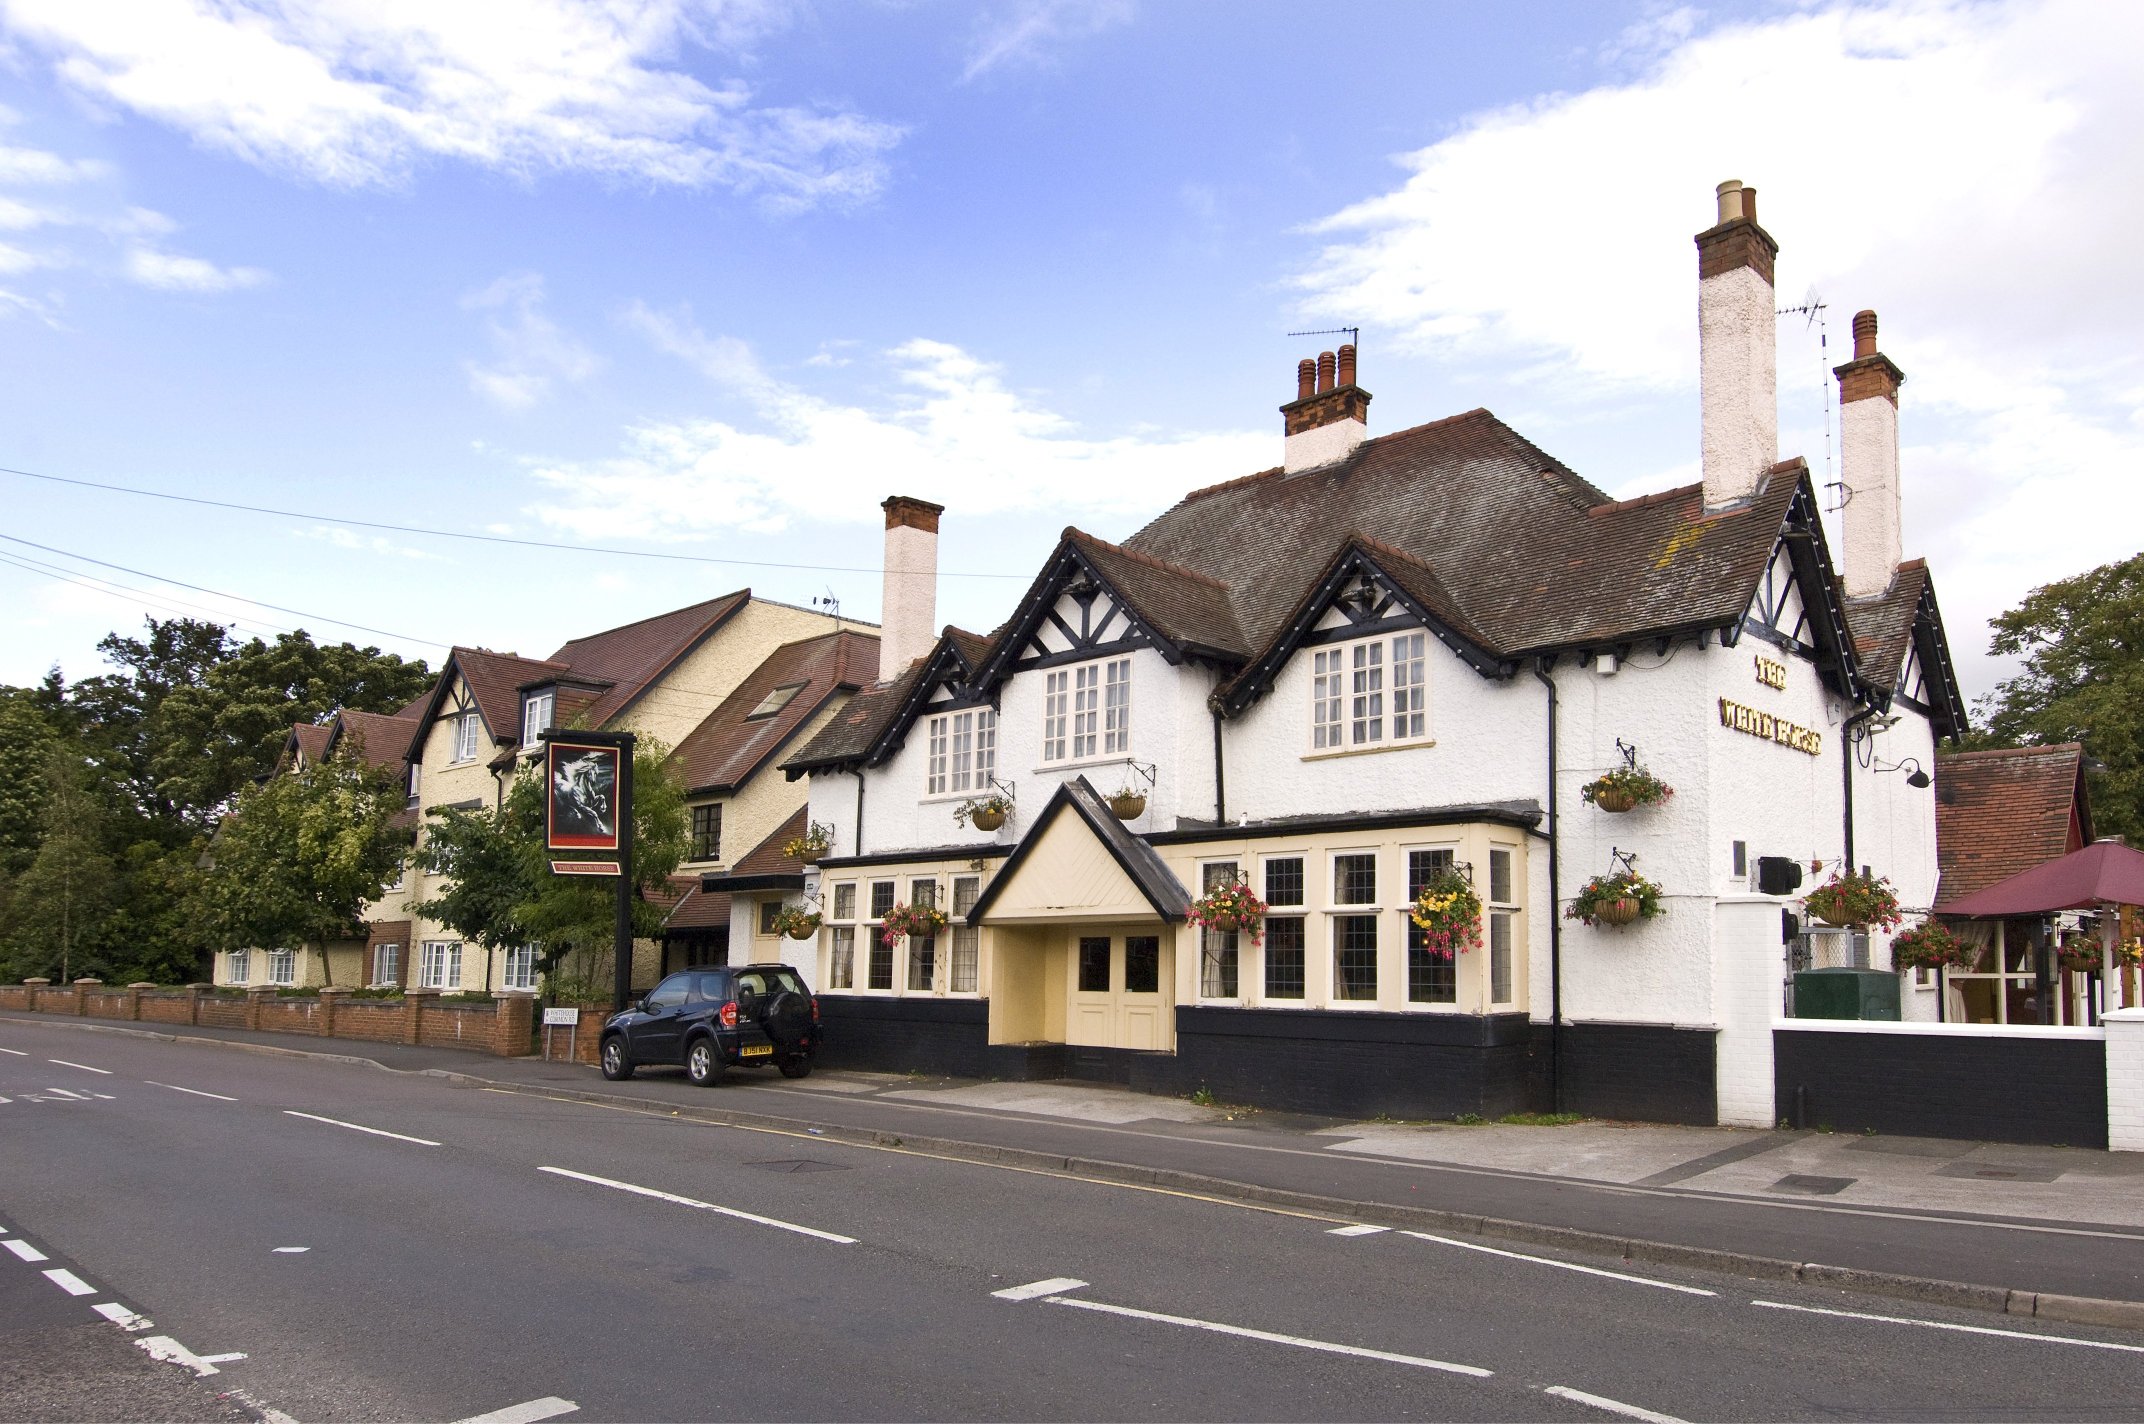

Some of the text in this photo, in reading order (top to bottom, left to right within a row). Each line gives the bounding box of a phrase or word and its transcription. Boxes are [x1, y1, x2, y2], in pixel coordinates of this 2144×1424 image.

[1755, 654, 1786, 690] THE
[1718, 696, 1821, 756] WHITE HORSE
